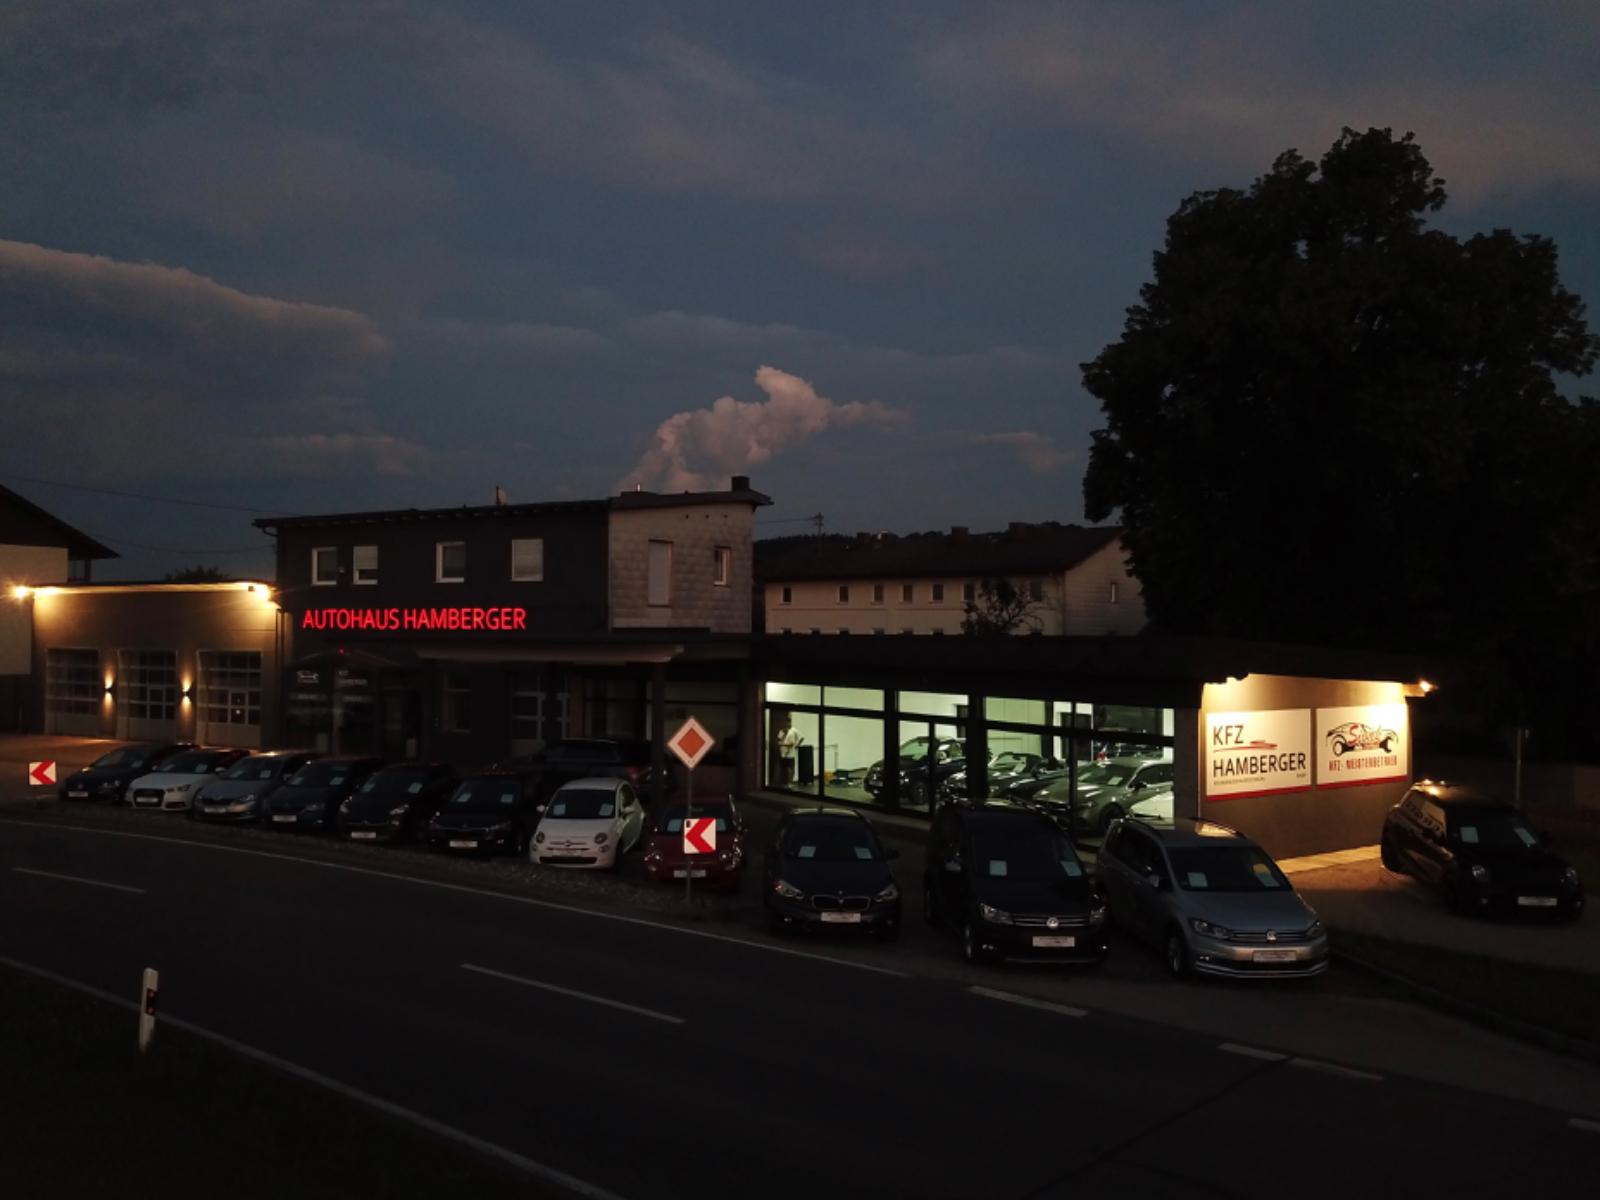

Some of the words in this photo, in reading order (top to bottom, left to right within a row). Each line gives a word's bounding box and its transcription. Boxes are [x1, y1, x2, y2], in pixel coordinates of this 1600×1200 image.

[303, 608, 399, 630] AUTOHAUS
[404, 607, 526, 630] HAMBERGER
[1213, 725, 1244, 746] KFZ
[1213, 752, 1306, 778] HAMBERGER
